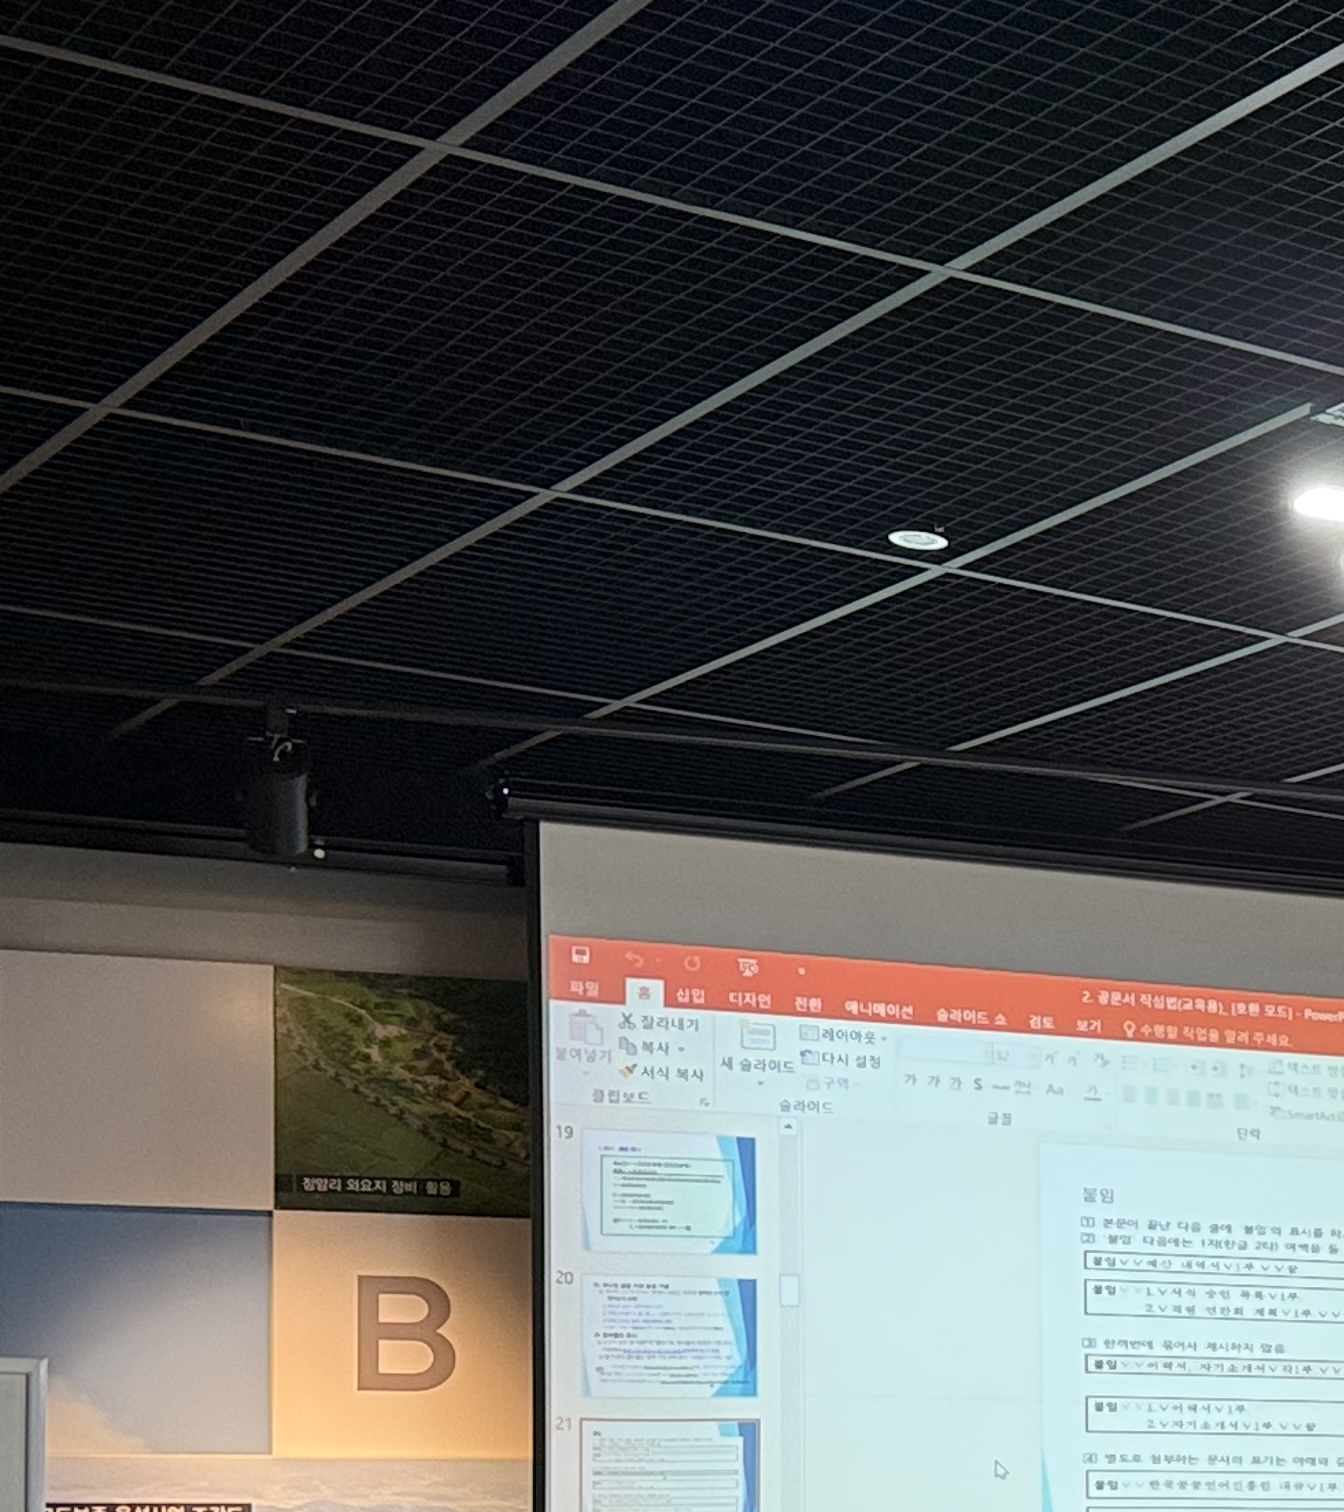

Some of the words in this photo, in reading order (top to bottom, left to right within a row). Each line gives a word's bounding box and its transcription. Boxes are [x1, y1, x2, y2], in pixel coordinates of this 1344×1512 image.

[570, 981, 599, 997] 파일
[638, 985, 651, 1000] 홈
[677, 988, 705, 1004] 삽입
[729, 993, 772, 1009] 디자인
[795, 996, 822, 1013] 전환
[844, 1000, 914, 1020] 애니메이션
[936, 1008, 990, 1025] 슬라이드
[1029, 1014, 1055, 1030] 검토
[1076, 1018, 1102, 1034] 보기
[1140, 1023, 1179, 1040] 수행할
[1182, 1025, 1220, 1043] 작업을
[1224, 1028, 1249, 1044] 알려
[1097, 991, 1136, 1007] 공문서
[1264, 1005, 1294, 1021] 모드]
[641, 1015, 699, 1032] 잘라내기
[822, 1027, 876, 1044] 레이아웃
[556, 1047, 612, 1064] 붙여넣기
[642, 1041, 669, 1056] 복사
[721, 1057, 733, 1071] 새
[740, 1058, 795, 1074] 슬라이드
[822, 1052, 849, 1067] 다시
[855, 1055, 881, 1070] 설정
[1288, 1061, 1322, 1076] 텍스트
[641, 1066, 669, 1081] 서식
[676, 1067, 704, 1082] 복사
[592, 1089, 651, 1104] 클립보드
[1288, 1082, 1322, 1098] 텍스트
[779, 1099, 834, 1114] 슬라이드
[987, 1111, 1012, 1126] 글꼴
[556, 1124, 574, 1140] 19
[1237, 1127, 1262, 1141] 단락
[1083, 1187, 1115, 1204] 붙임
[1177, 1221, 1202, 1233] 다음
[1142, 1235, 1193, 1248] 다음에는
[555, 1270, 574, 1285] 20
[357, 1274, 456, 1391] B
[556, 1417, 572, 1431] 21
